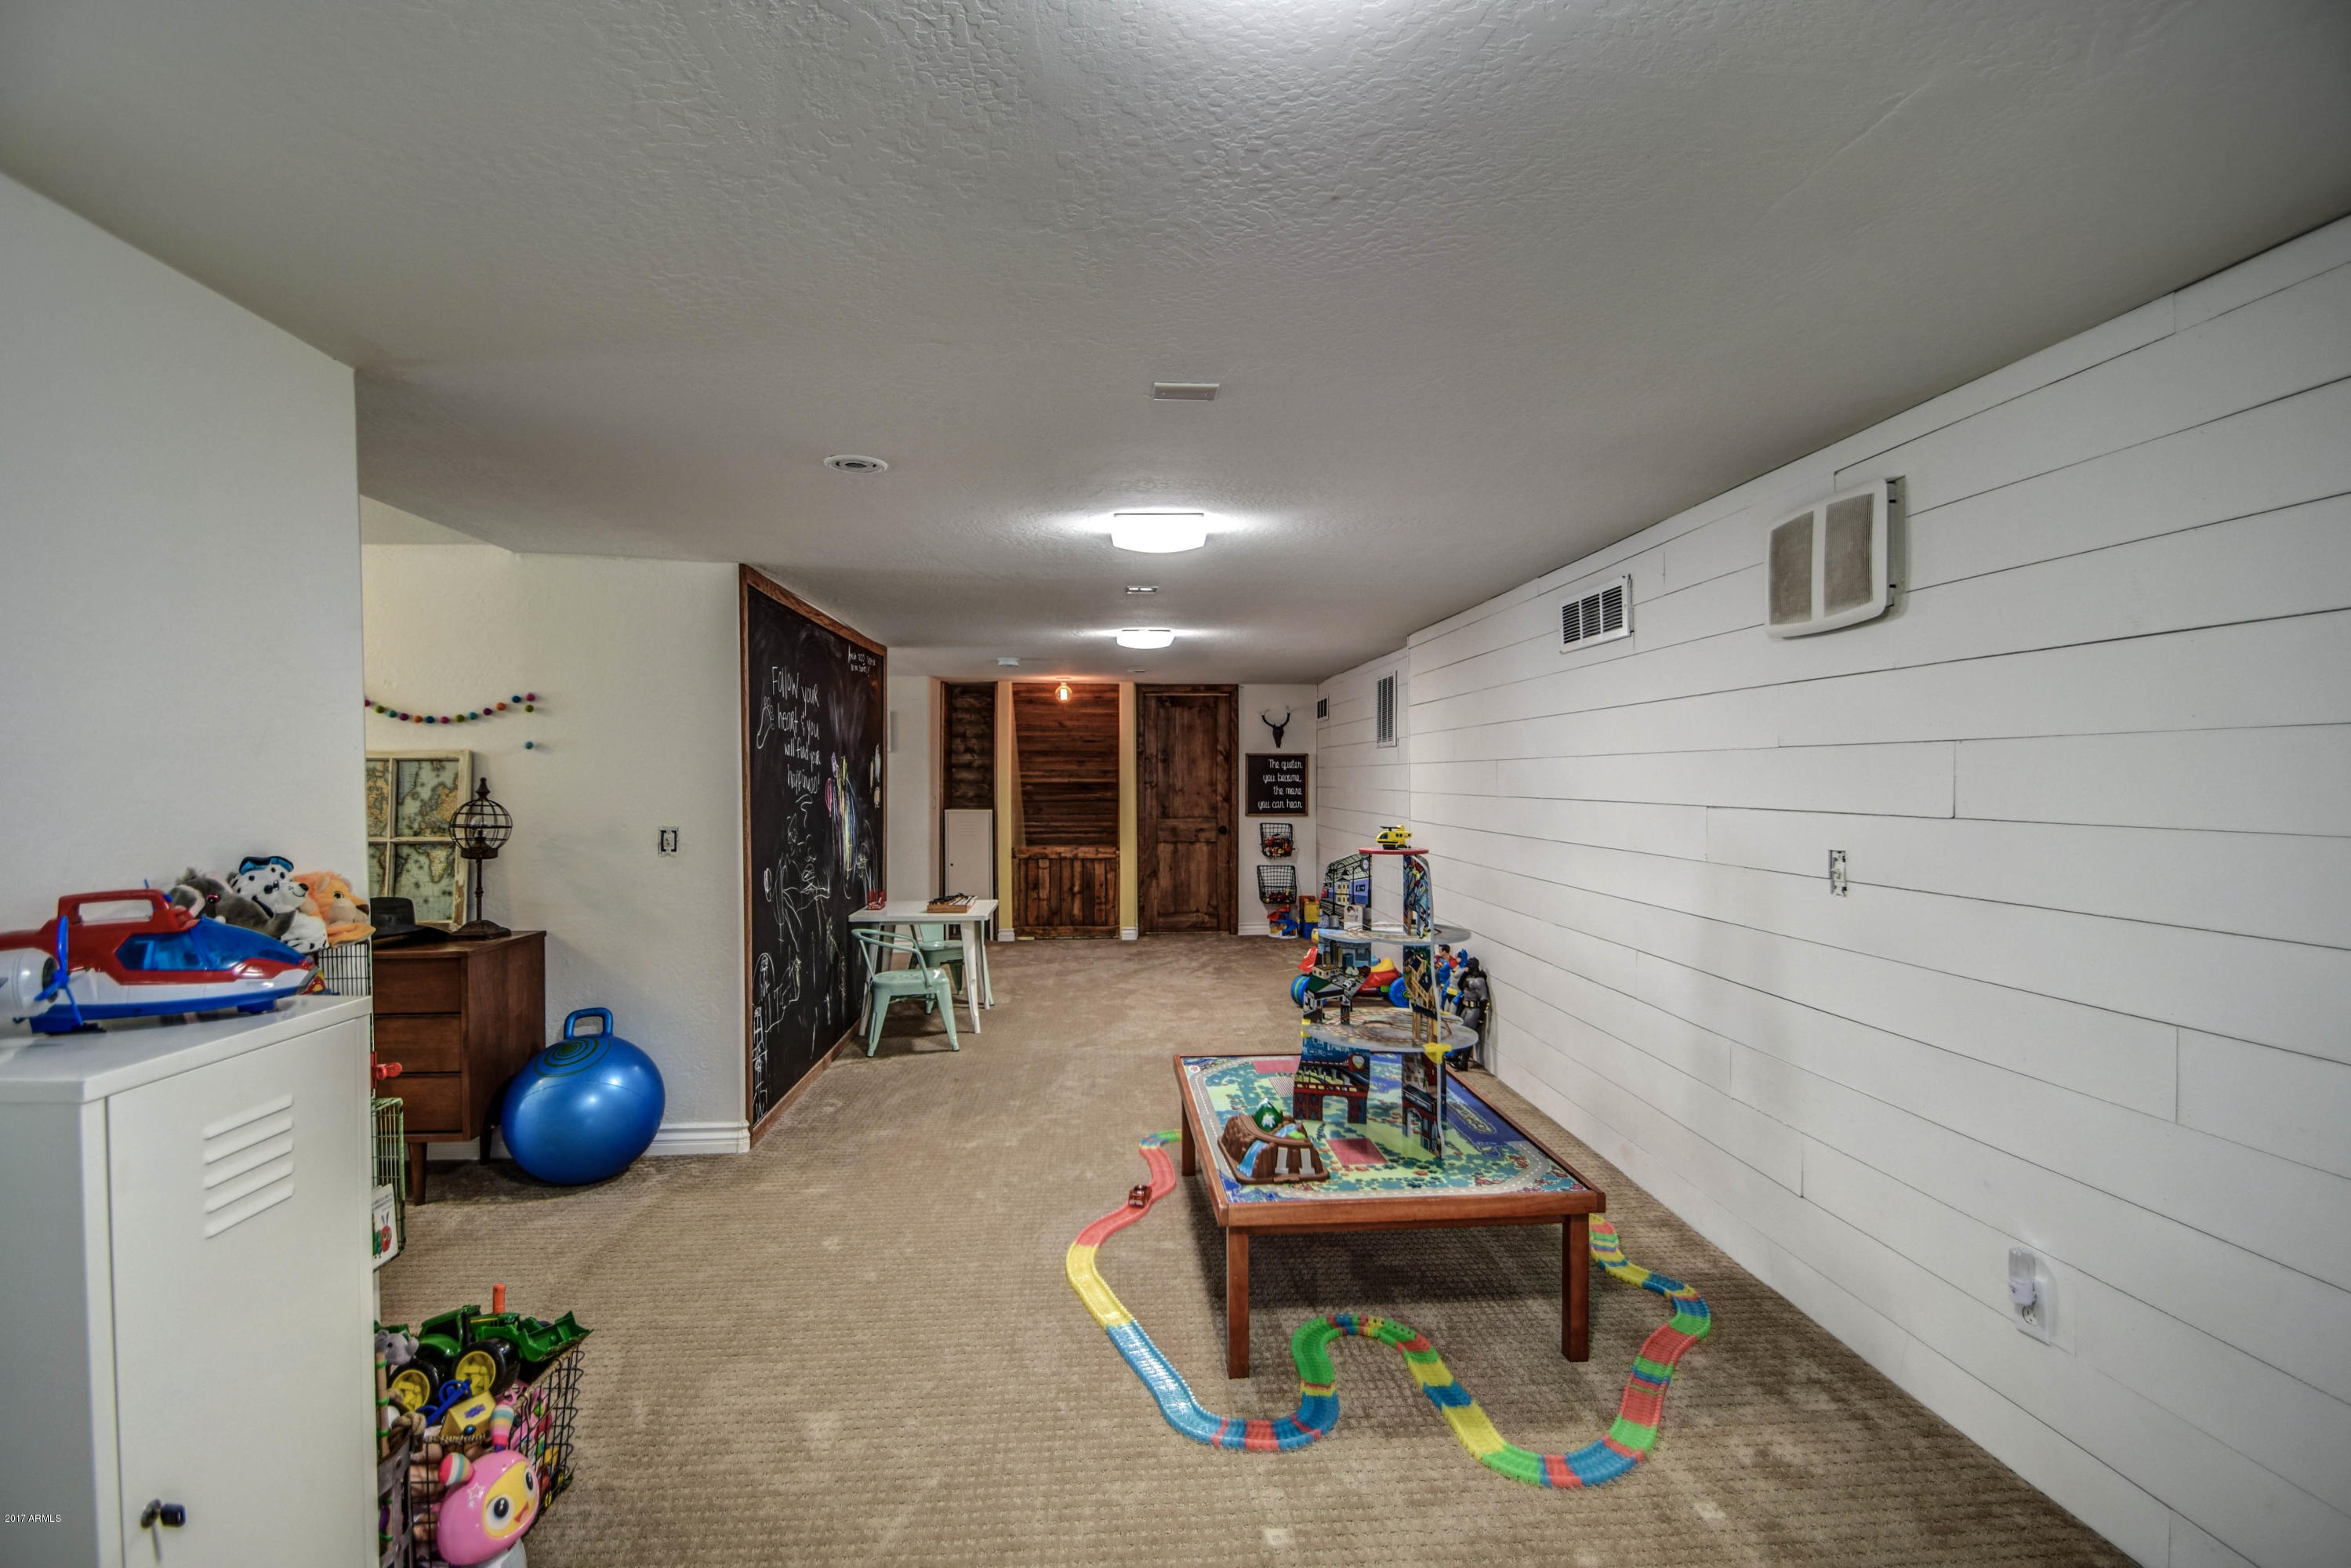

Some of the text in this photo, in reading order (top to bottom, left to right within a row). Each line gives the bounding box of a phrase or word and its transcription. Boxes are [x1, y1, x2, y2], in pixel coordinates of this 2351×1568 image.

[1268, 758, 1303, 771] The quieter
[1262, 774, 1275, 784] you
[1273, 785, 1284, 795] the
[1257, 800, 1271, 811] you
[1286, 798, 1303, 808] hear
